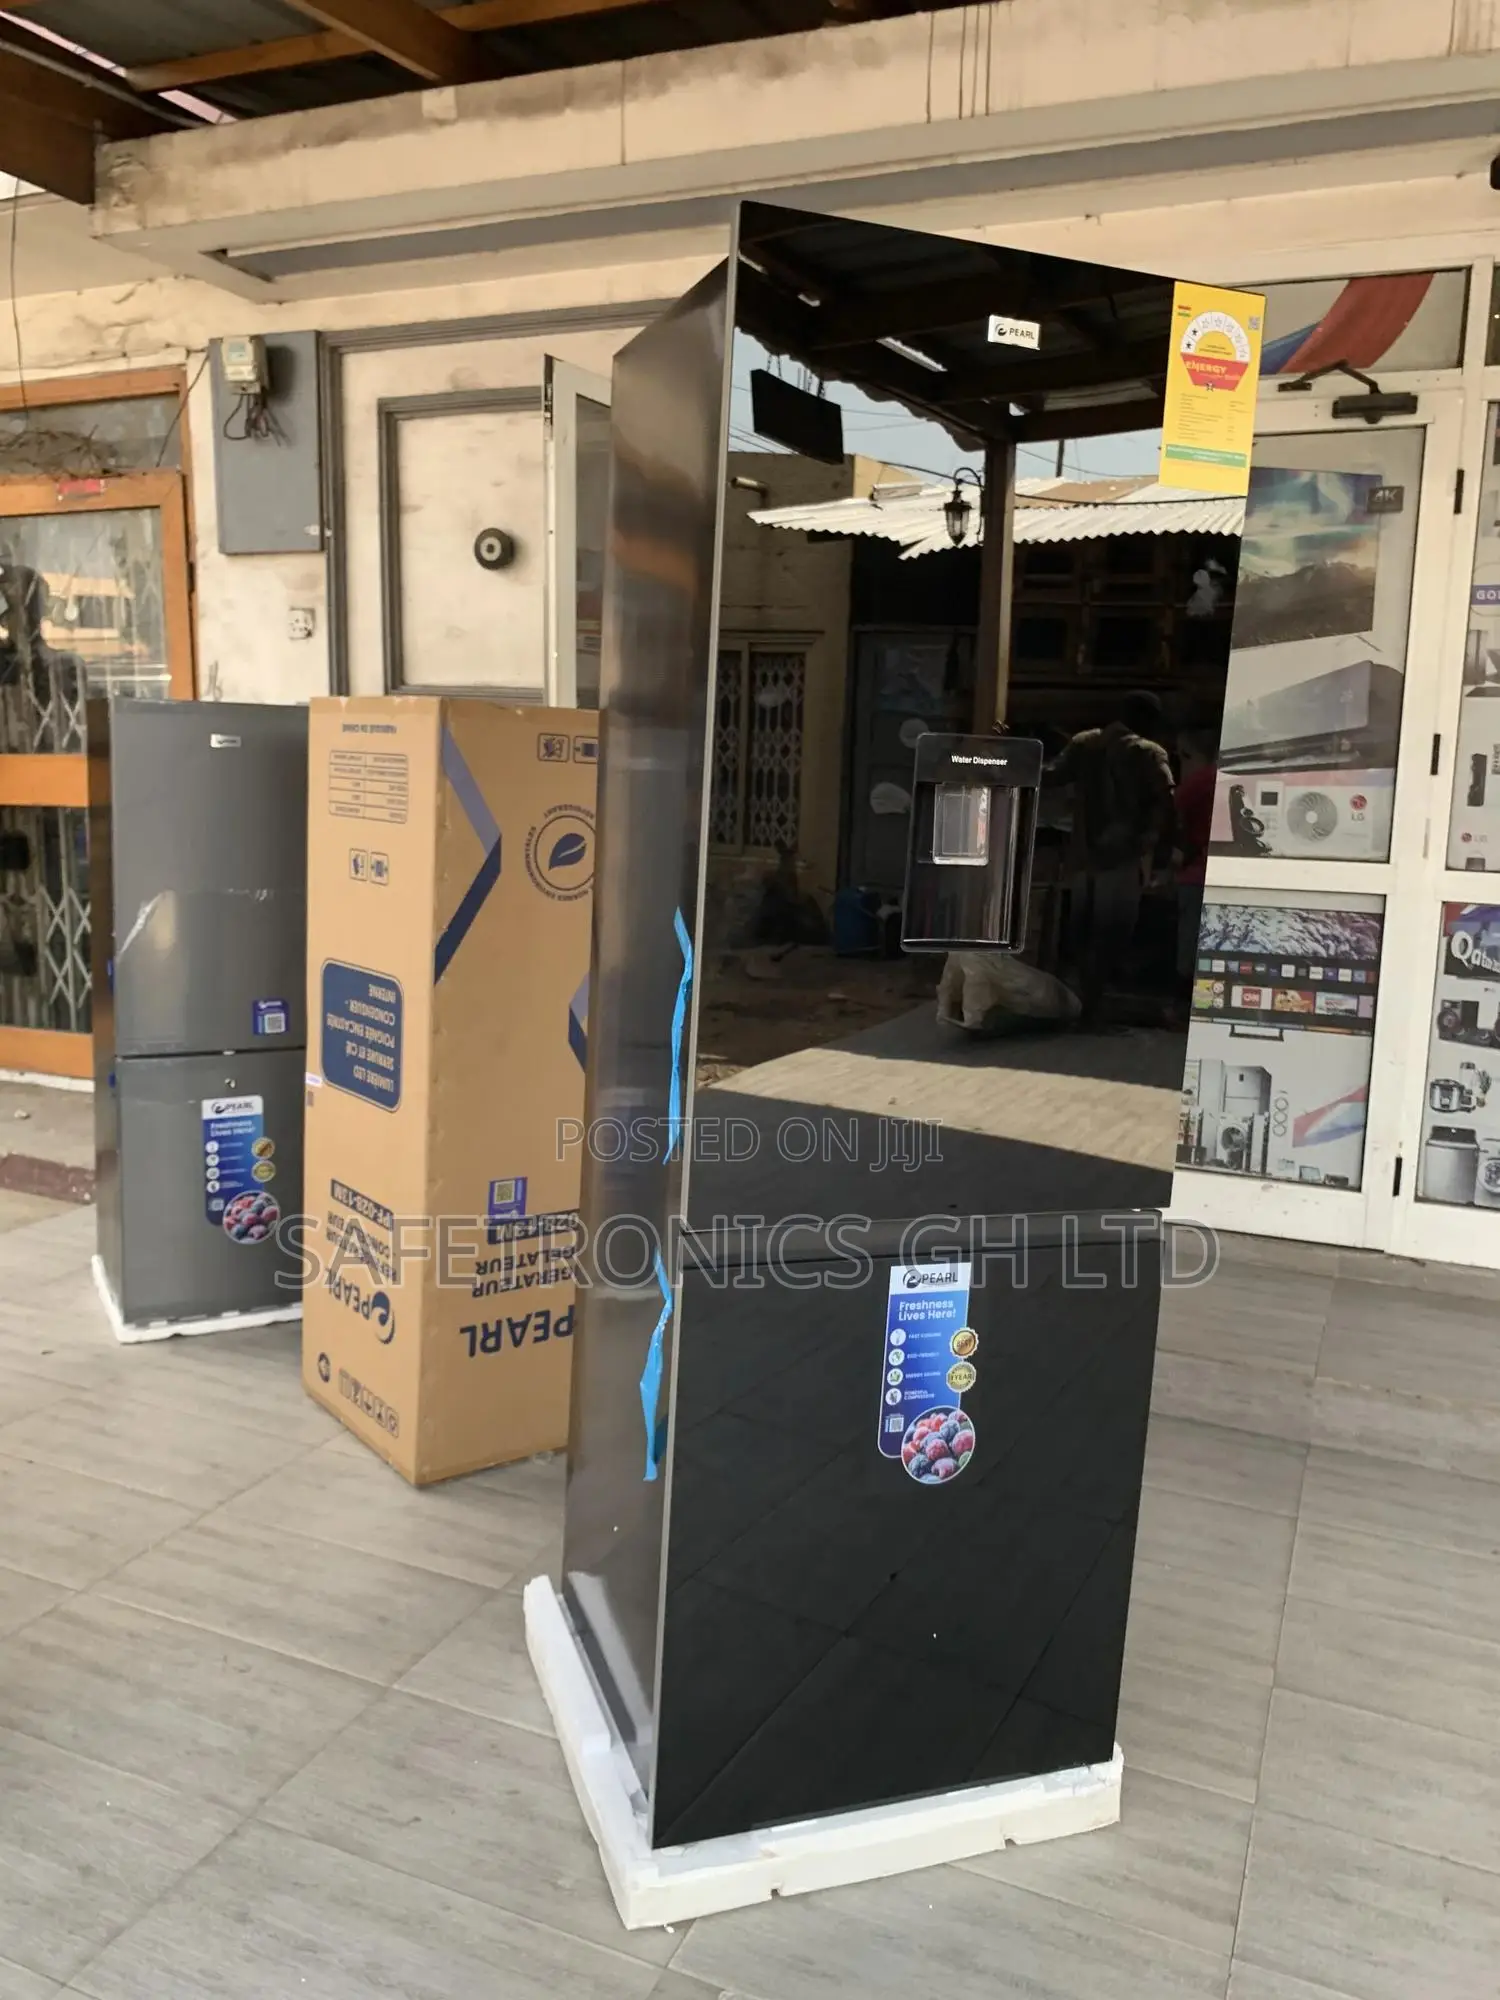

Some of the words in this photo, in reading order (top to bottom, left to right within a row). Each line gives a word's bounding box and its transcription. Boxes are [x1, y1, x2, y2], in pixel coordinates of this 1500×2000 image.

[1008, 327, 1035, 340] PEARL
[1476, 590, 1500, 600] GO
[951, 755, 972, 764] Water
[973, 756, 1008, 766] Dispenser
[1351, 813, 1365, 822] LG
[922, 1271, 958, 1284] PEARL
[325, 1266, 371, 1321] PEARL
[899, 1299, 954, 1311] Freshness
[898, 1311, 926, 1321] Lives
[928, 1309, 956, 1320] Here!
[460, 1304, 576, 1358] PEARL
